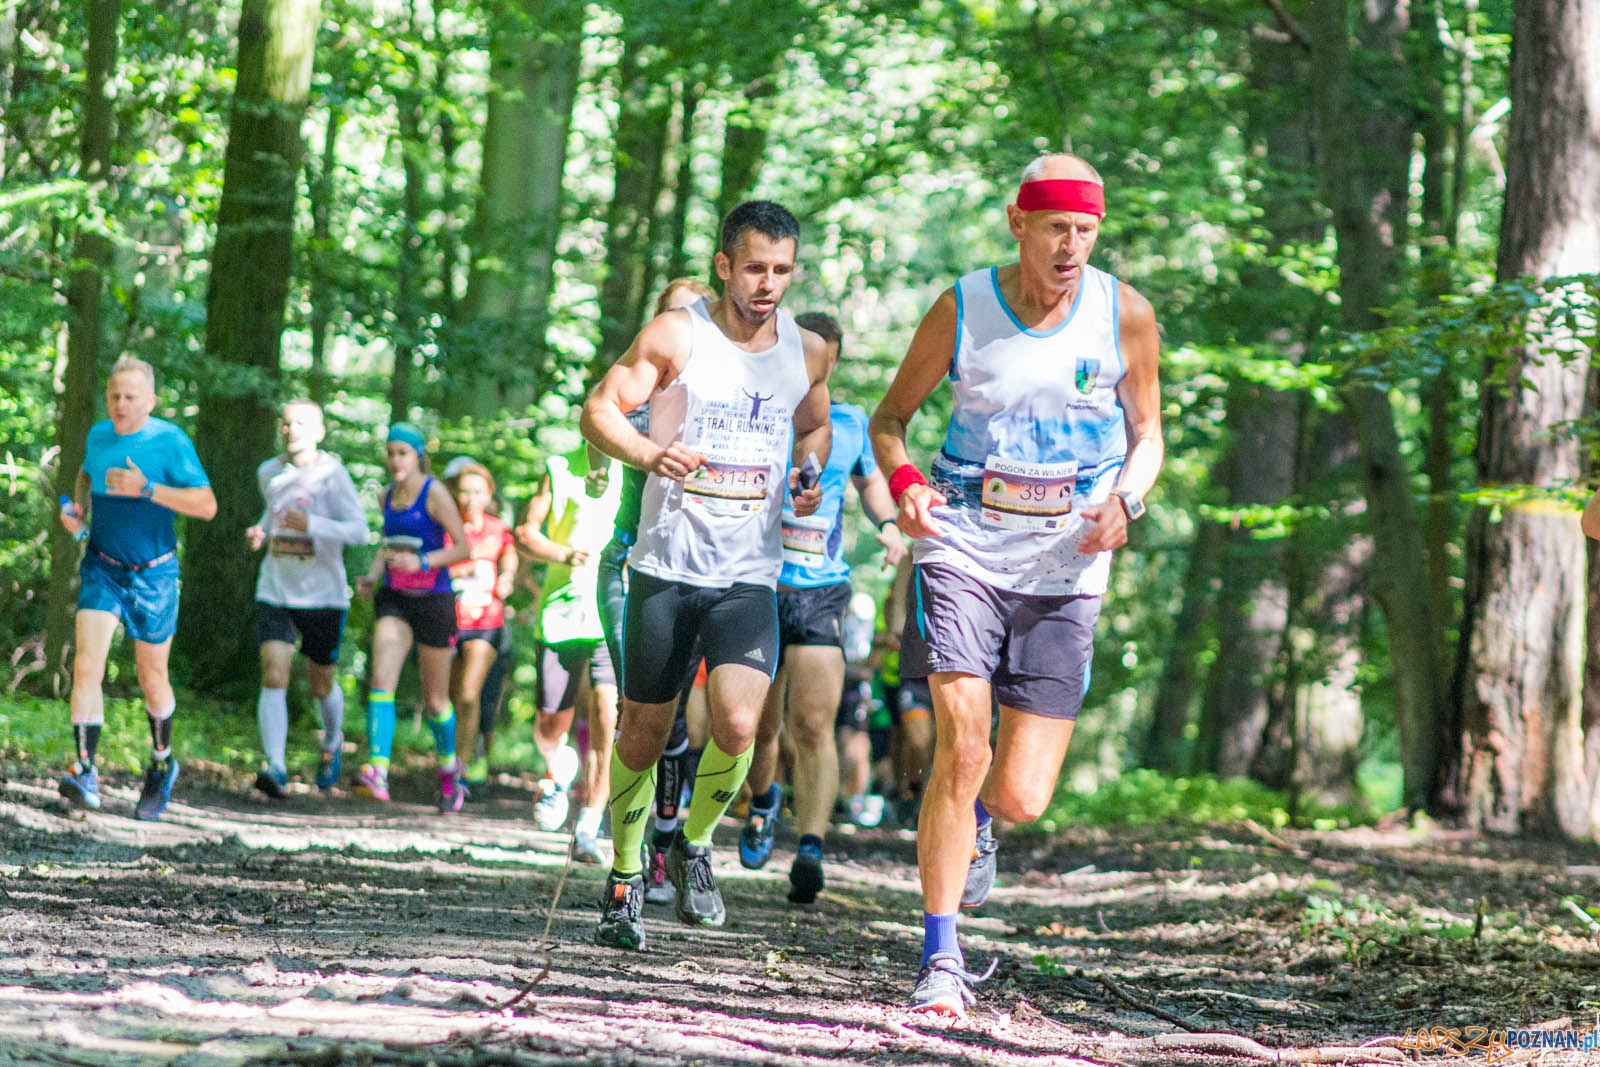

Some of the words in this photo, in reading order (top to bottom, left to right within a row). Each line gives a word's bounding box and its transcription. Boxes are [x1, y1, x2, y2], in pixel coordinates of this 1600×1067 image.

[707, 417, 734, 433] TRAIL
[737, 419, 776, 436] RUNNING
[713, 469, 748, 487] 314
[1028, 468, 1040, 477] ZA
[1020, 482, 1047, 502] 39
